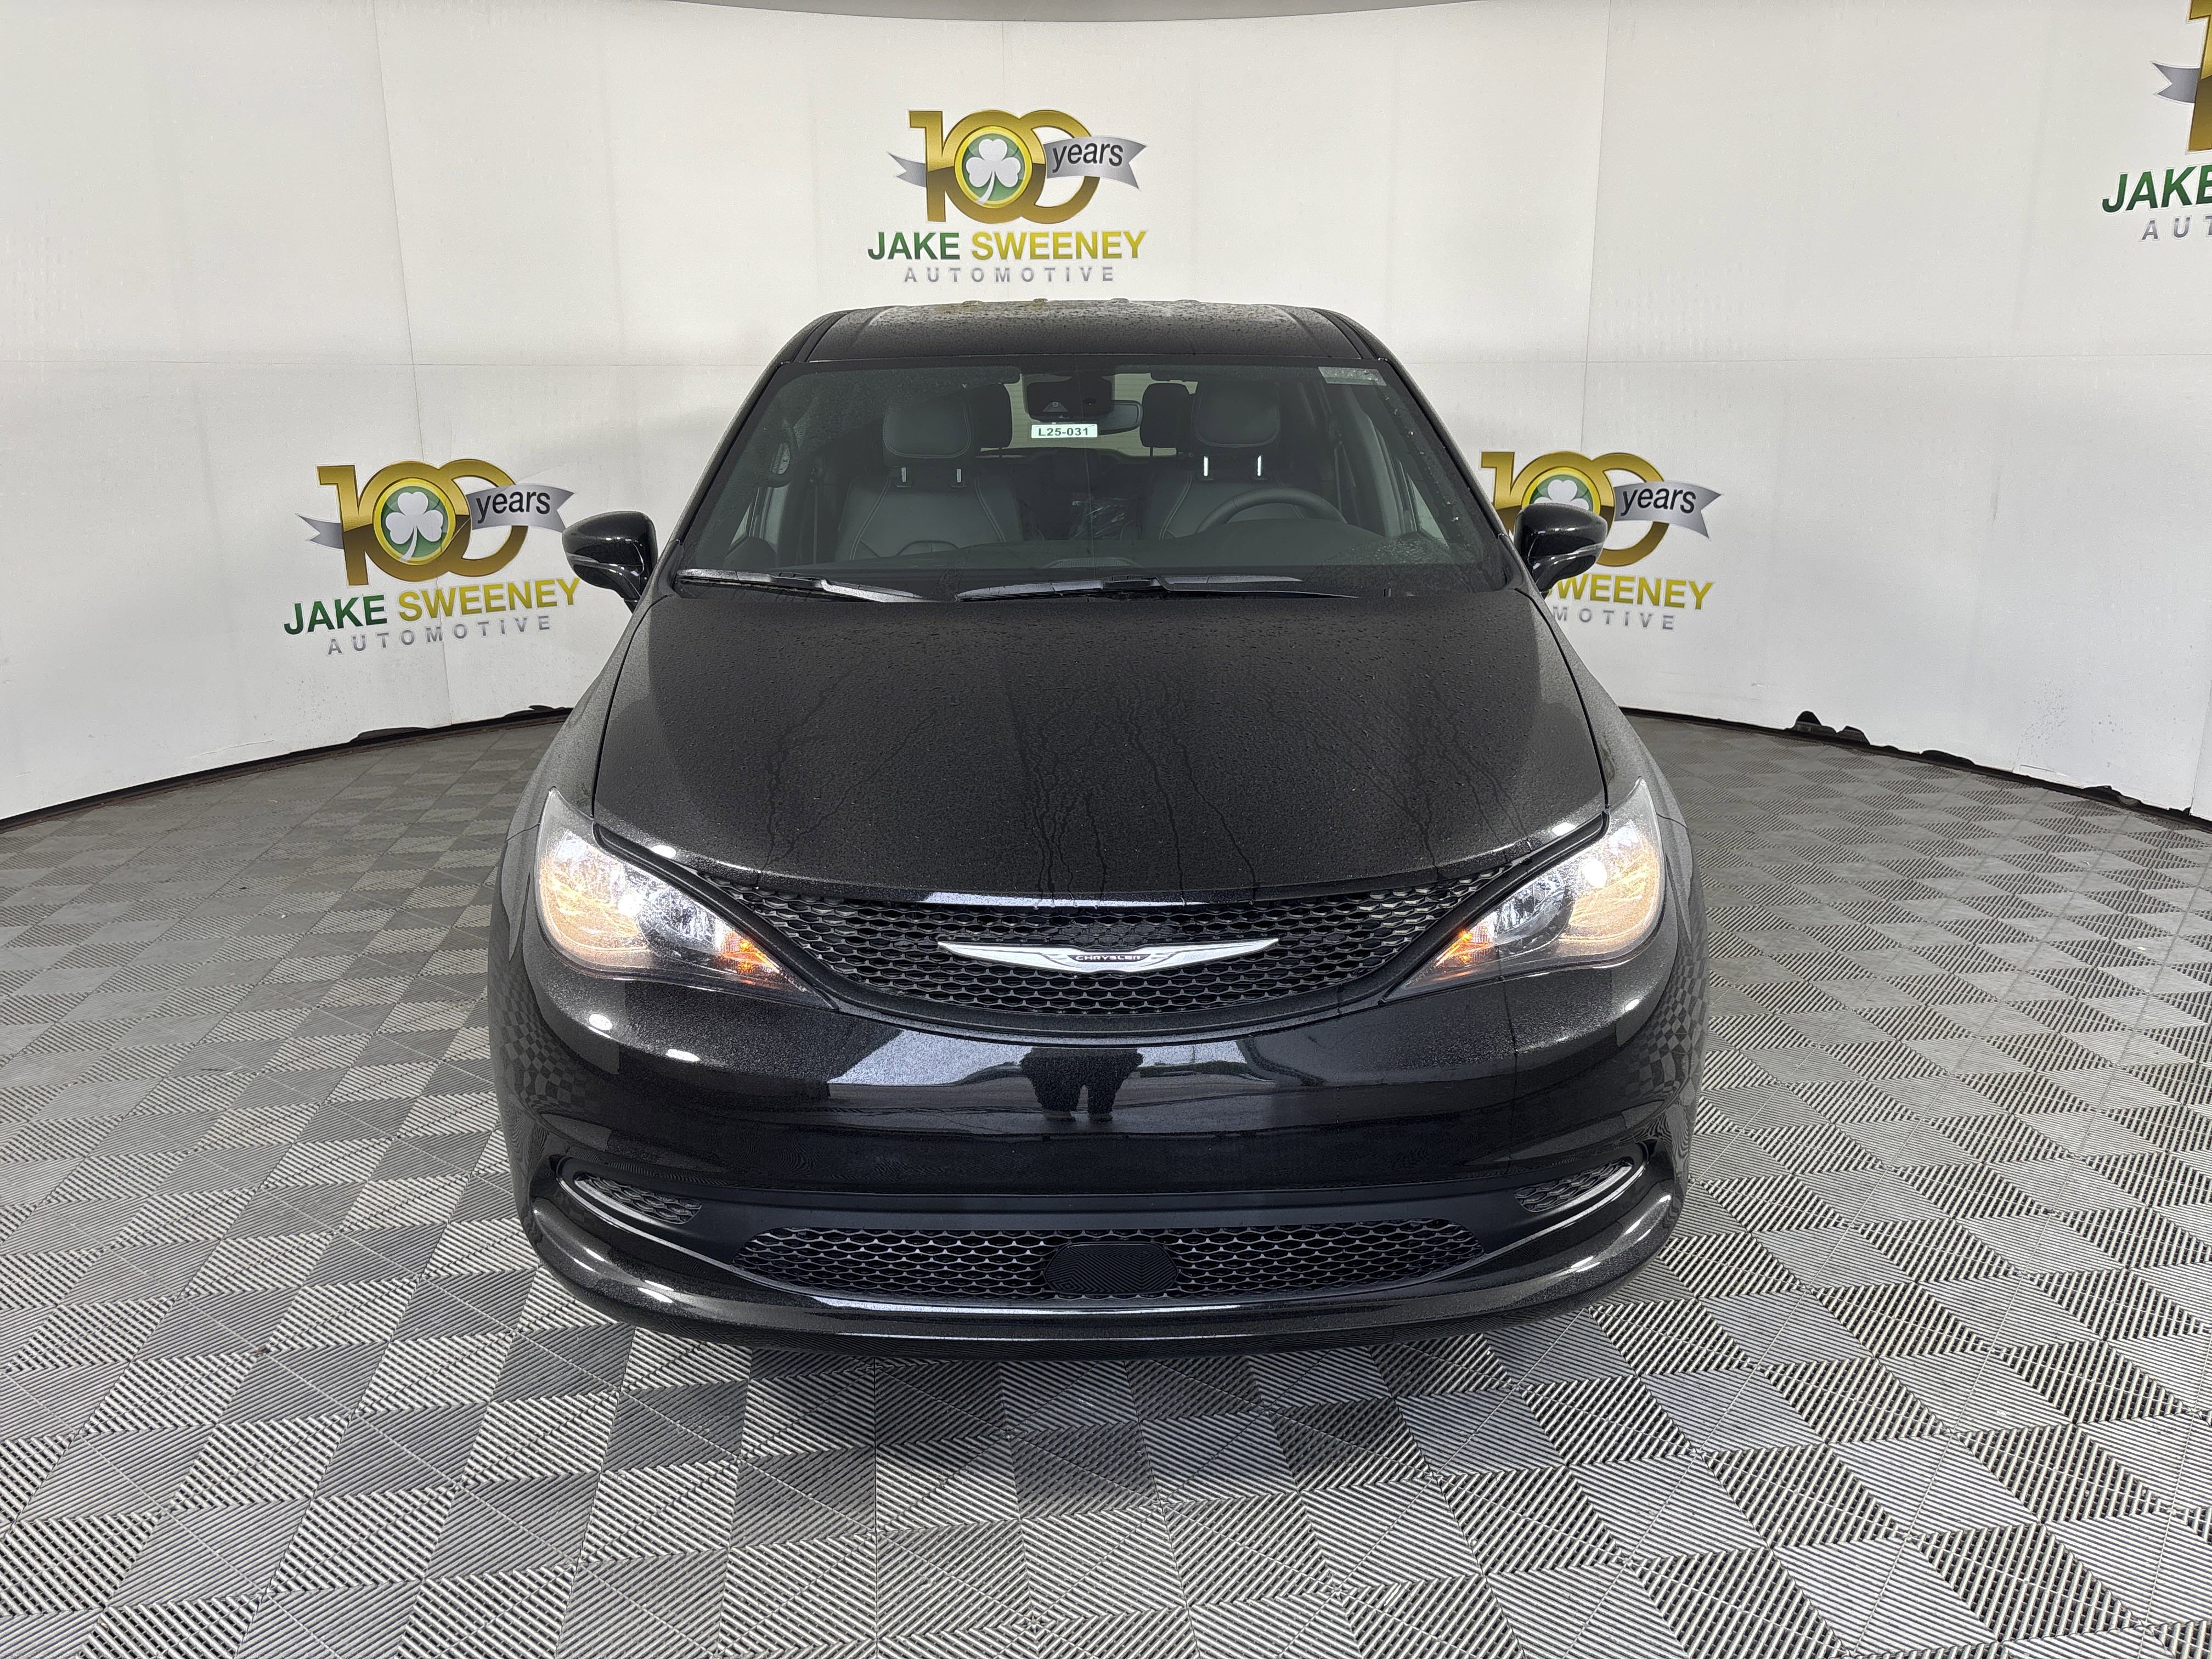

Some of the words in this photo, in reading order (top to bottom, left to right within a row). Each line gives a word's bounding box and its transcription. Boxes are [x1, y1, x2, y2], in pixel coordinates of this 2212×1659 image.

[909, 109, 1101, 224] 100
[1052, 141, 1123, 173] years
[868, 232, 960, 261] JAKE
[972, 231, 1147, 259] SWEENEY
[904, 267, 1114, 283] AUTOMOTIVE
[1039, 427, 1088, 436] L25-031
[1621, 488, 1696, 516] years
[317, 459, 529, 585] 100
[476, 491, 551, 523] years
[284, 595, 388, 635] JAKE
[398, 578, 580, 622] SWEENEY
[1548, 573, 1714, 610] WEENEY
[1552, 606, 1674, 630] MOTIVE
[328, 616, 551, 655] AUTOMOTIVE
